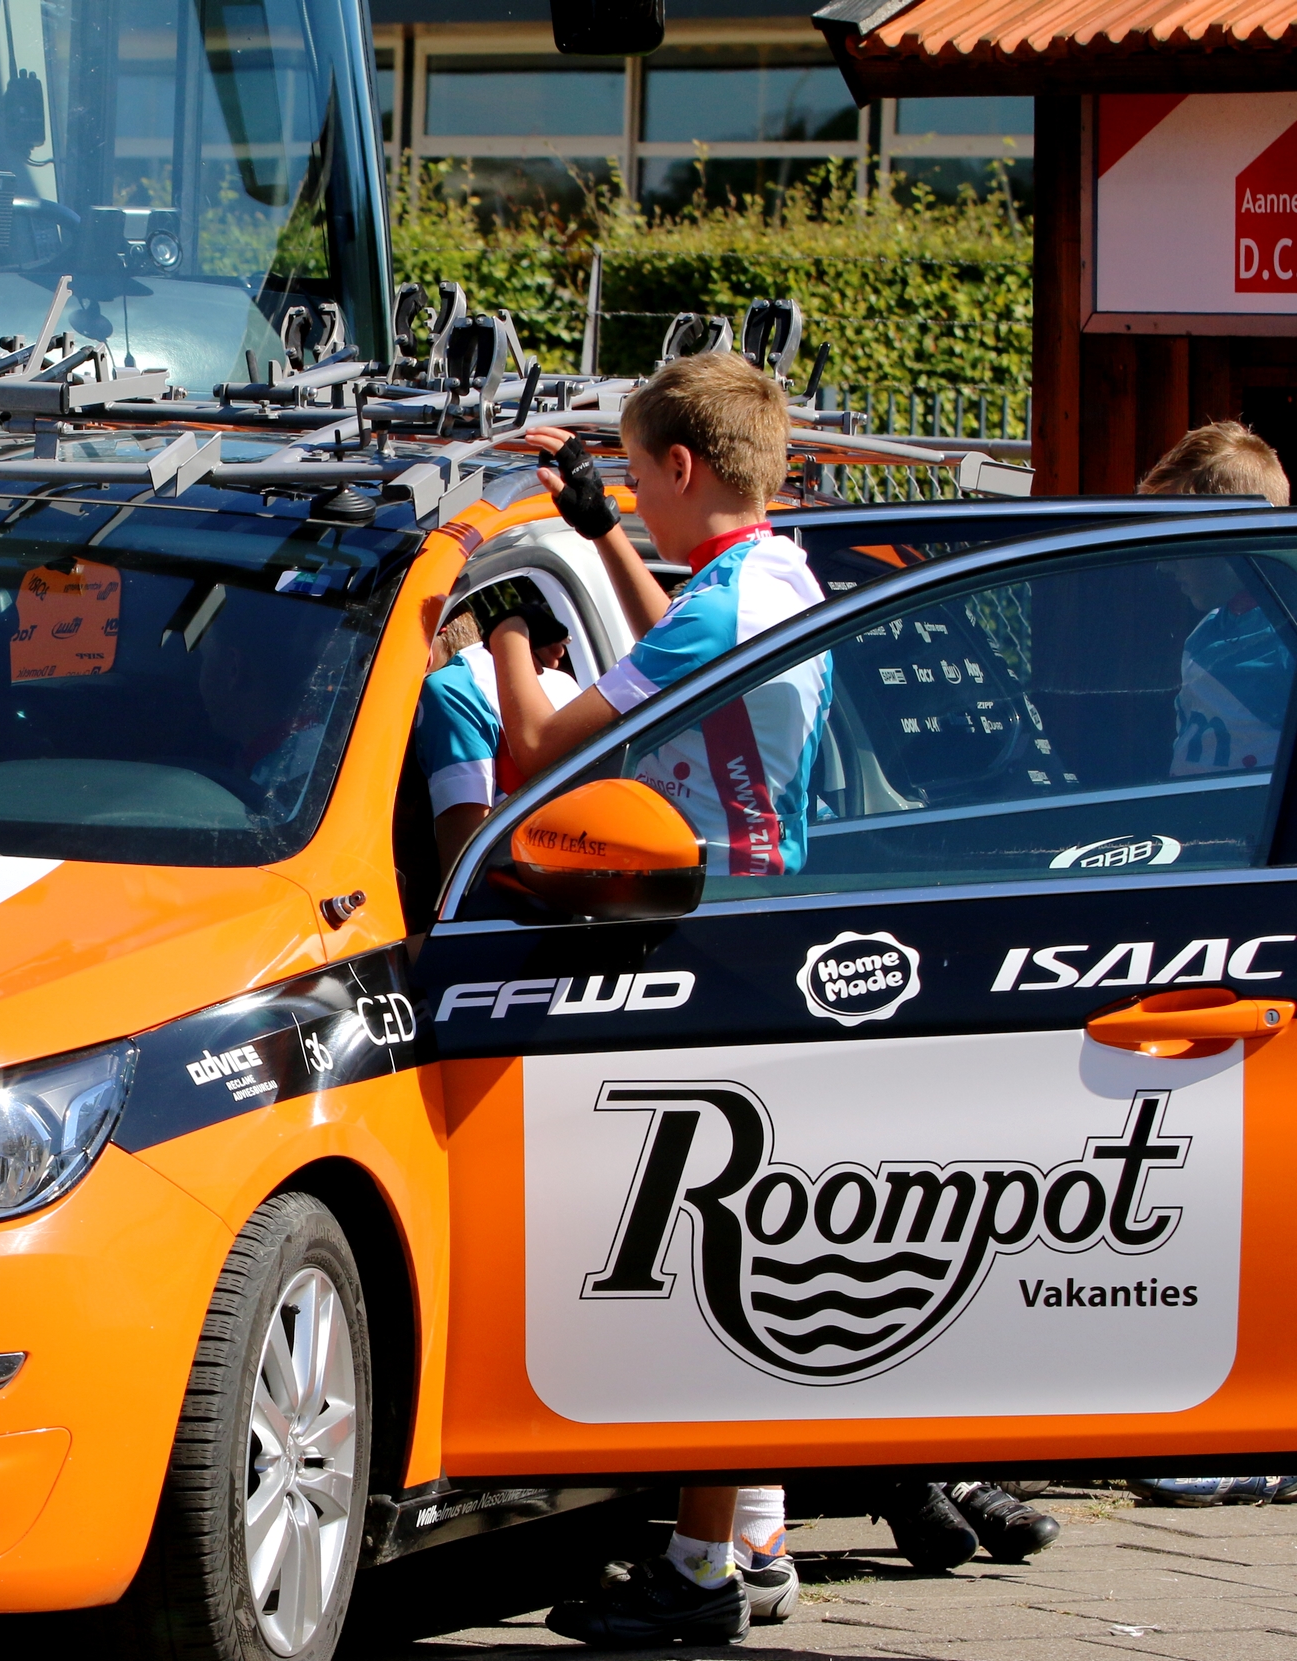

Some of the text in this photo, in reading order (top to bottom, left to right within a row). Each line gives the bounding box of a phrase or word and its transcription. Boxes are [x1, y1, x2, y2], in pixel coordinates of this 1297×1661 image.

[1241, 187, 1297, 214] Aanne
[1239, 237, 1297, 281] D.C
[977, 701, 994, 710] ZIPP
[524, 828, 559, 850] MKB
[817, 951, 900, 983] Home
[990, 934, 1297, 992] ISAAC
[434, 970, 696, 1023] FFWD
[824, 969, 904, 1003] Made
[356, 993, 417, 1046] CED
[225, 1074, 257, 1091] RECLAME
[232, 1079, 278, 1102] ADVIESBUREAU
[579, 1080, 1193, 1387] Roompot
[1017, 1278, 1199, 1309] Vakanties
[415, 1502, 463, 1527] Wilhelmus
[461, 1500, 477, 1514] van
